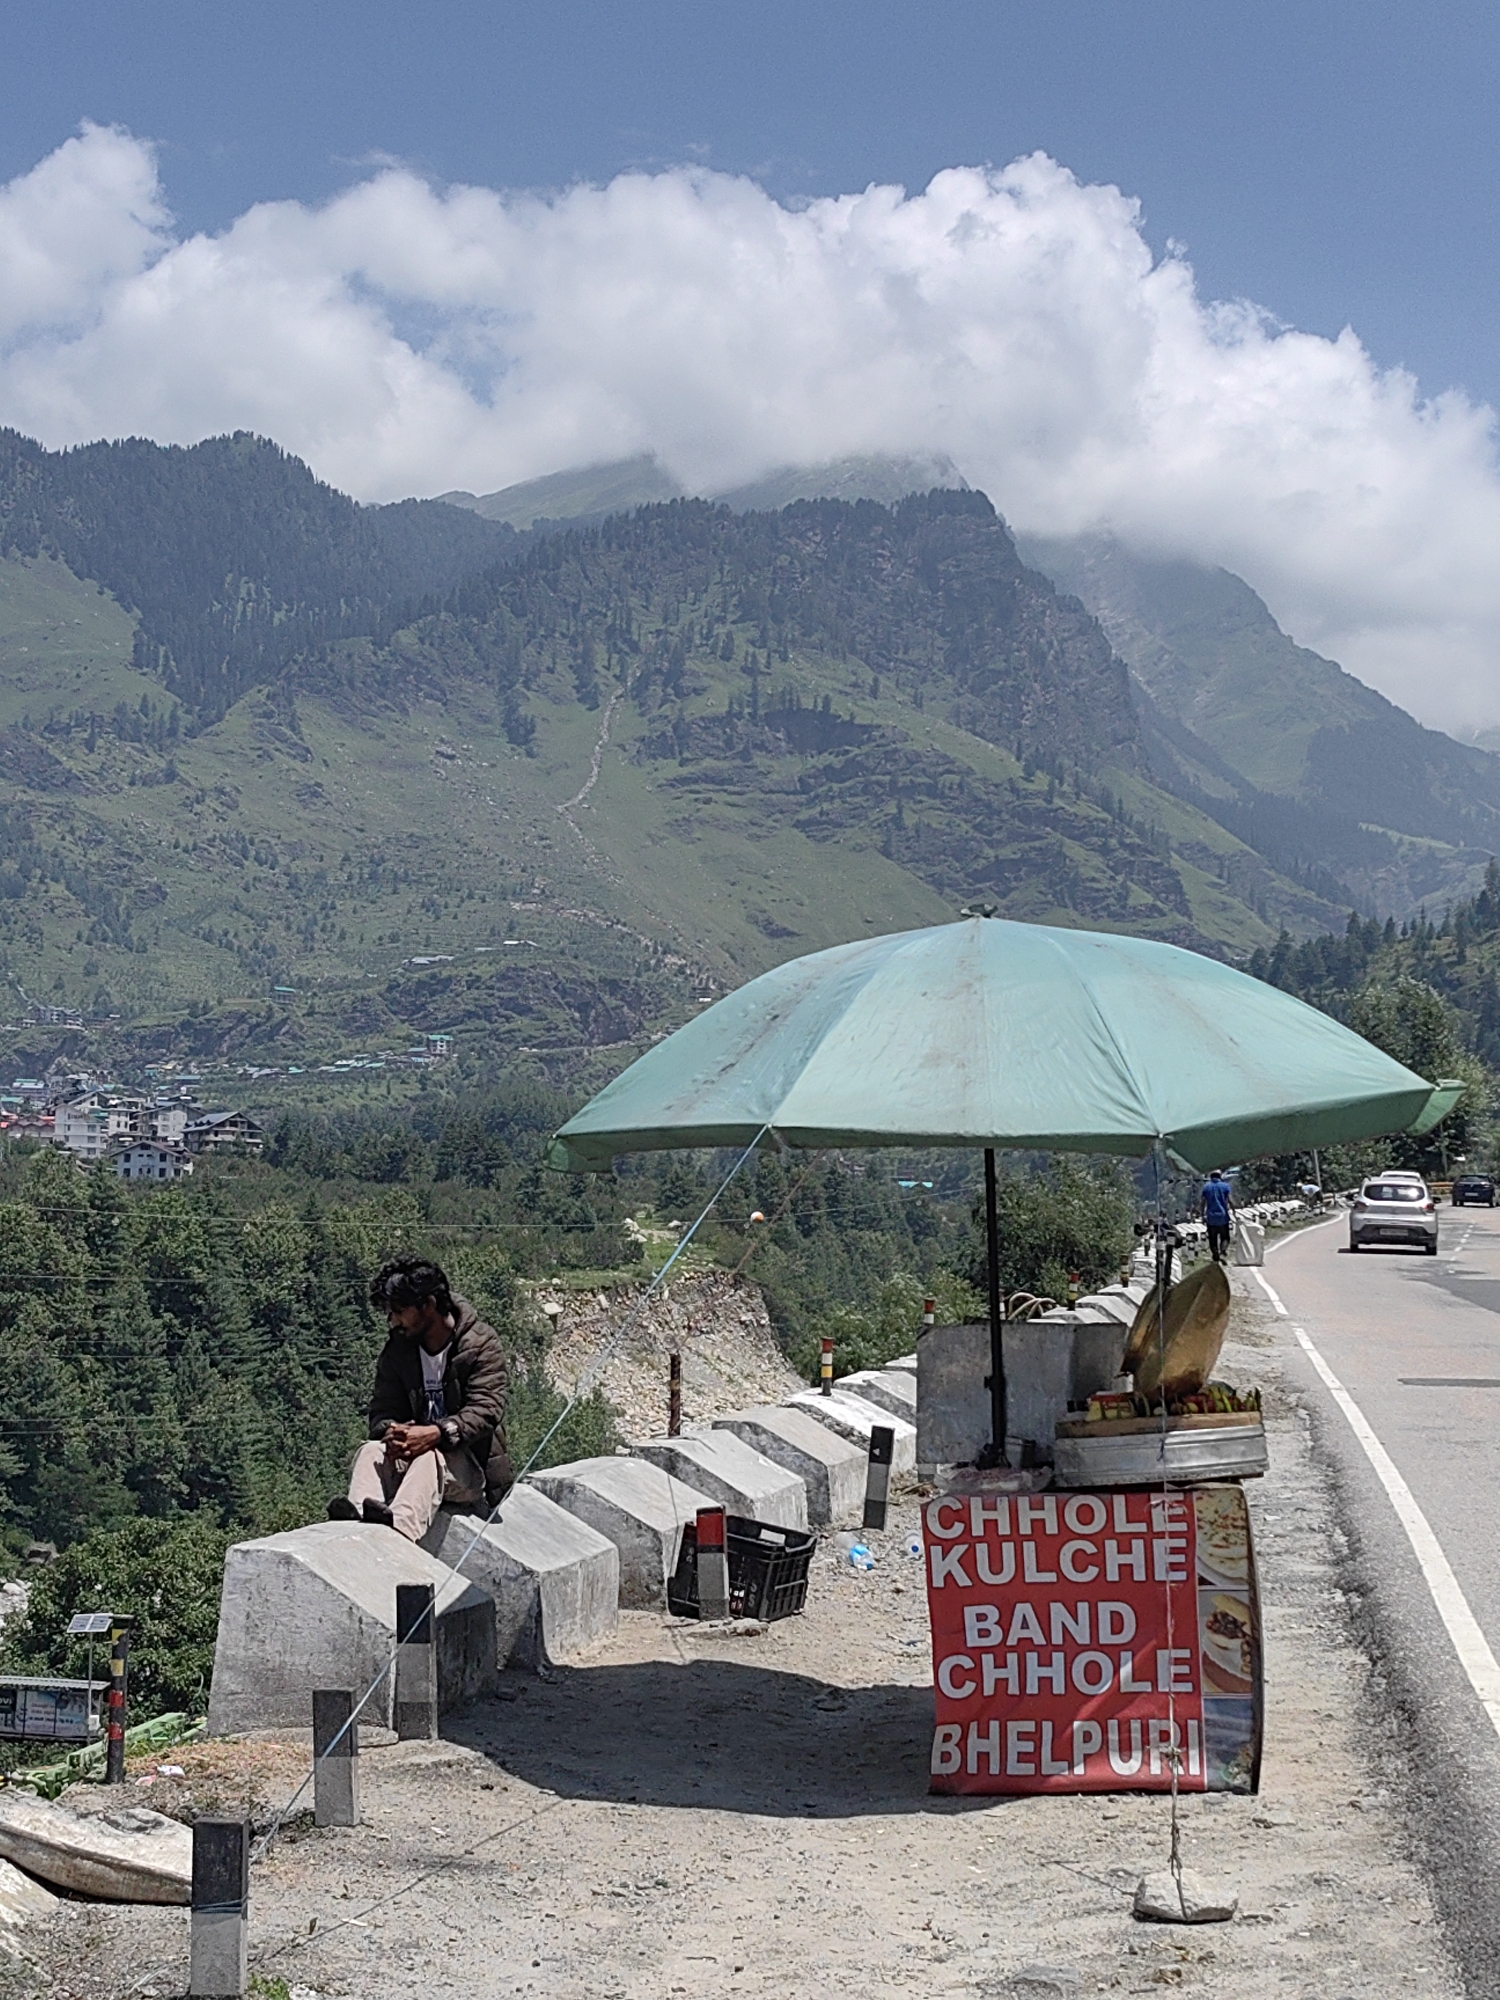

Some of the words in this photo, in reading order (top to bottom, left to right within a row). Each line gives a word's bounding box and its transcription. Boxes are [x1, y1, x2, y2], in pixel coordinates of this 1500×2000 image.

[926, 1493, 1189, 1540] CHHOLE
[930, 1537, 1188, 1588] KULCHE
[963, 1601, 1137, 1648] BAND
[937, 1648, 1193, 1699] CHHOLE
[930, 1718, 1201, 1777] BHELPURI
